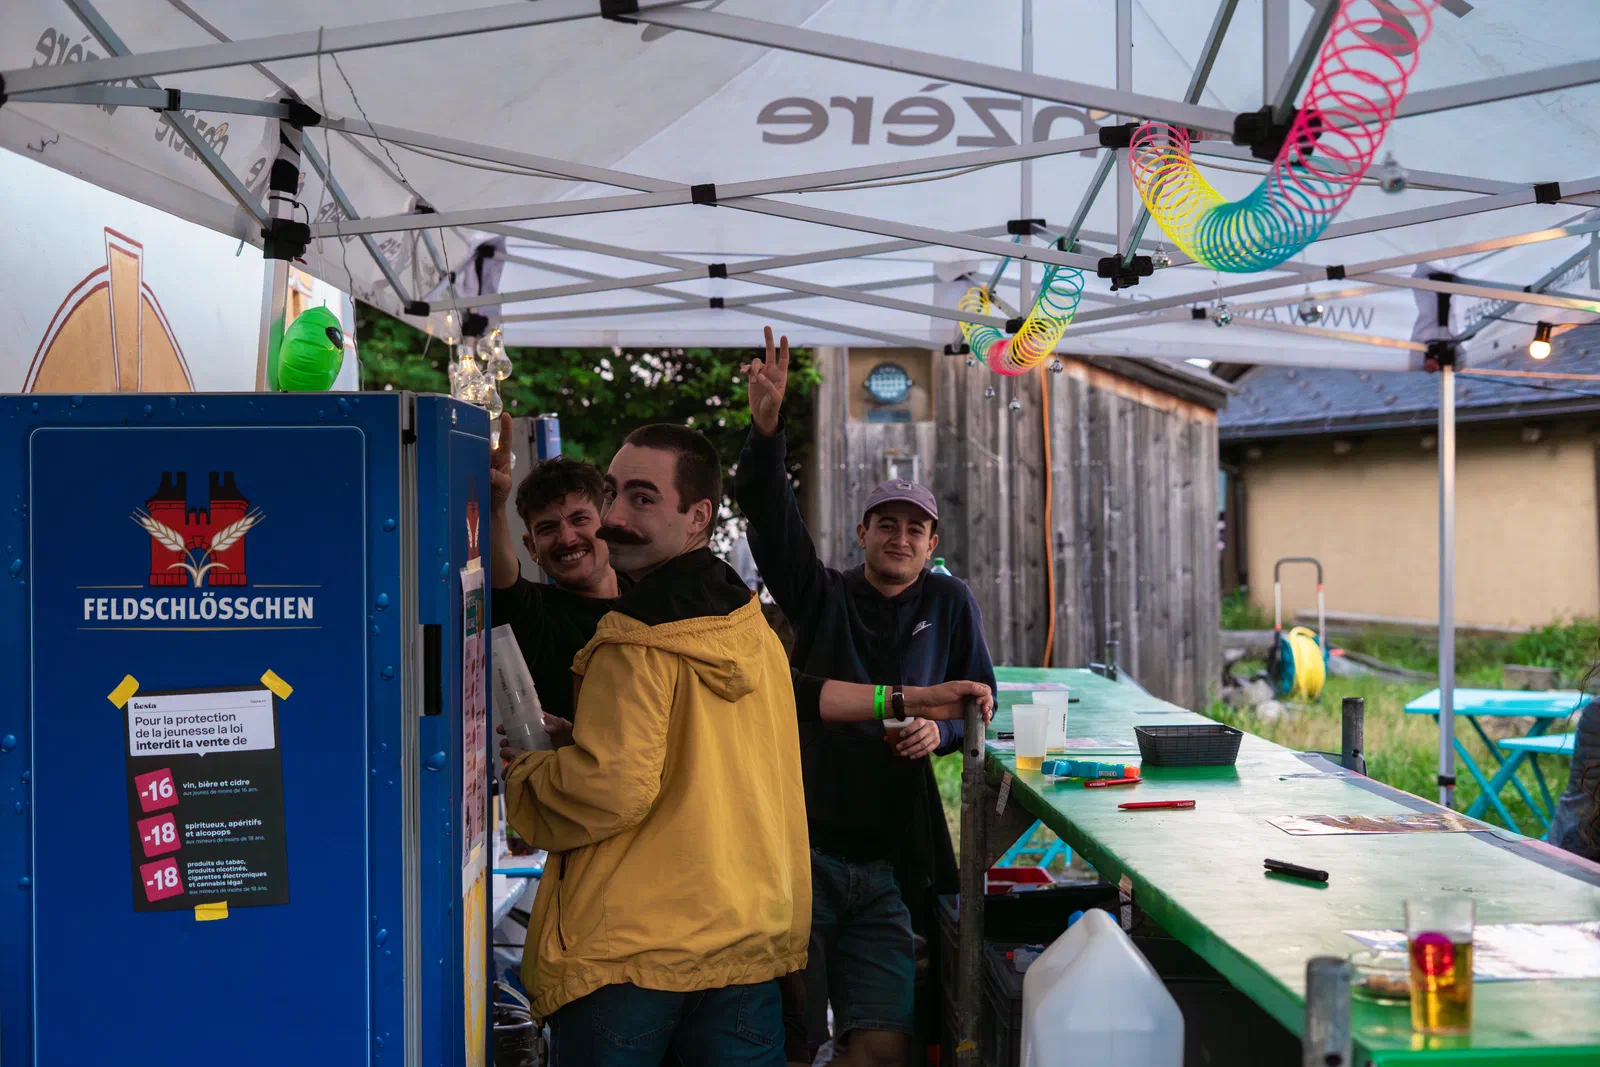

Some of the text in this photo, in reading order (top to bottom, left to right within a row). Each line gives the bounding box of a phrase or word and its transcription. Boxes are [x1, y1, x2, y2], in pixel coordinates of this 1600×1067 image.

[83, 591, 315, 621] FELDSCHLÖSSCHEN
[135, 713, 236, 726] Pour la protection
[136, 724, 243, 739] de la jeunesse la loi
[136, 736, 247, 750] interdit la vente de
[141, 777, 173, 801] -16
[198, 780, 218, 788] bière
[185, 819, 262, 830] spiritueux, apéritifs
[144, 822, 176, 846] -18
[195, 829, 231, 837] alcopops
[147, 866, 179, 890] -18
